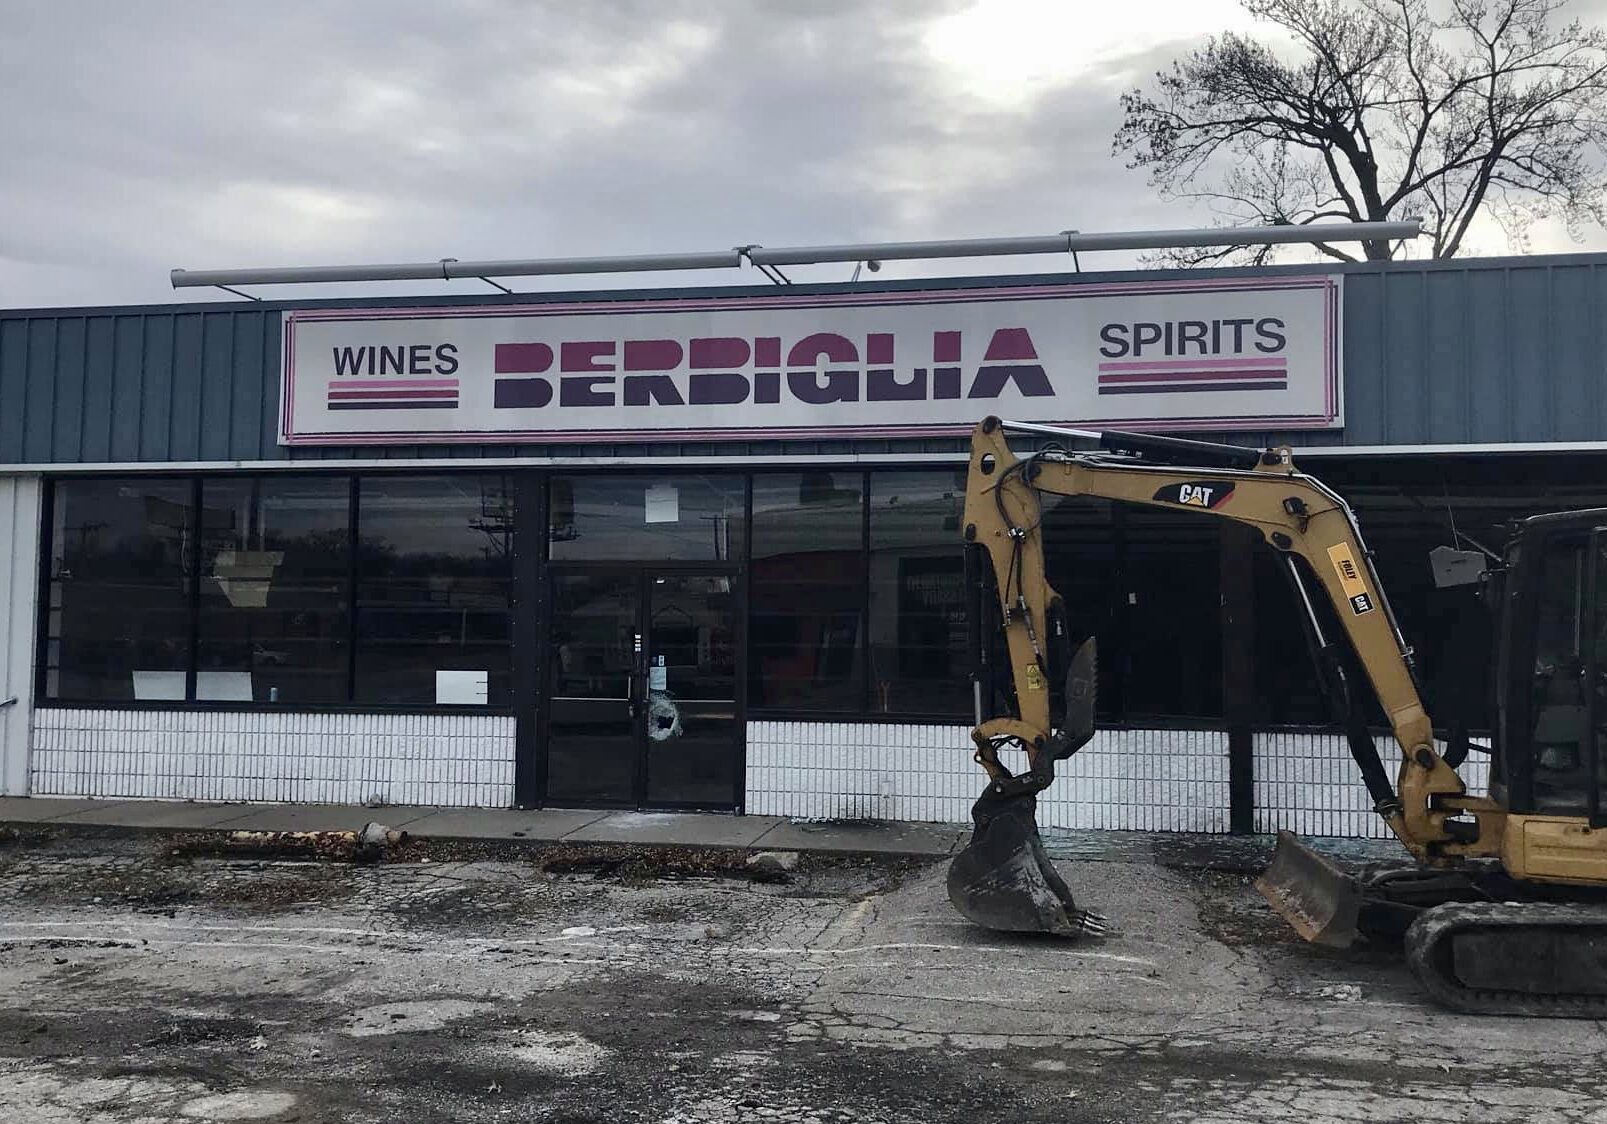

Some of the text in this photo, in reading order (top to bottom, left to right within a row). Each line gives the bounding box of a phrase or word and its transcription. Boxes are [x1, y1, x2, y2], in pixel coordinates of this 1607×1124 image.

[1099, 317, 1288, 358] SPIRITS
[333, 343, 460, 376] WINES
[494, 327, 1056, 409] BERBIGLIA
[1179, 484, 1213, 507] CAT
[1342, 560, 1357, 579] FOLEY
[1354, 595, 1369, 611] CAT
